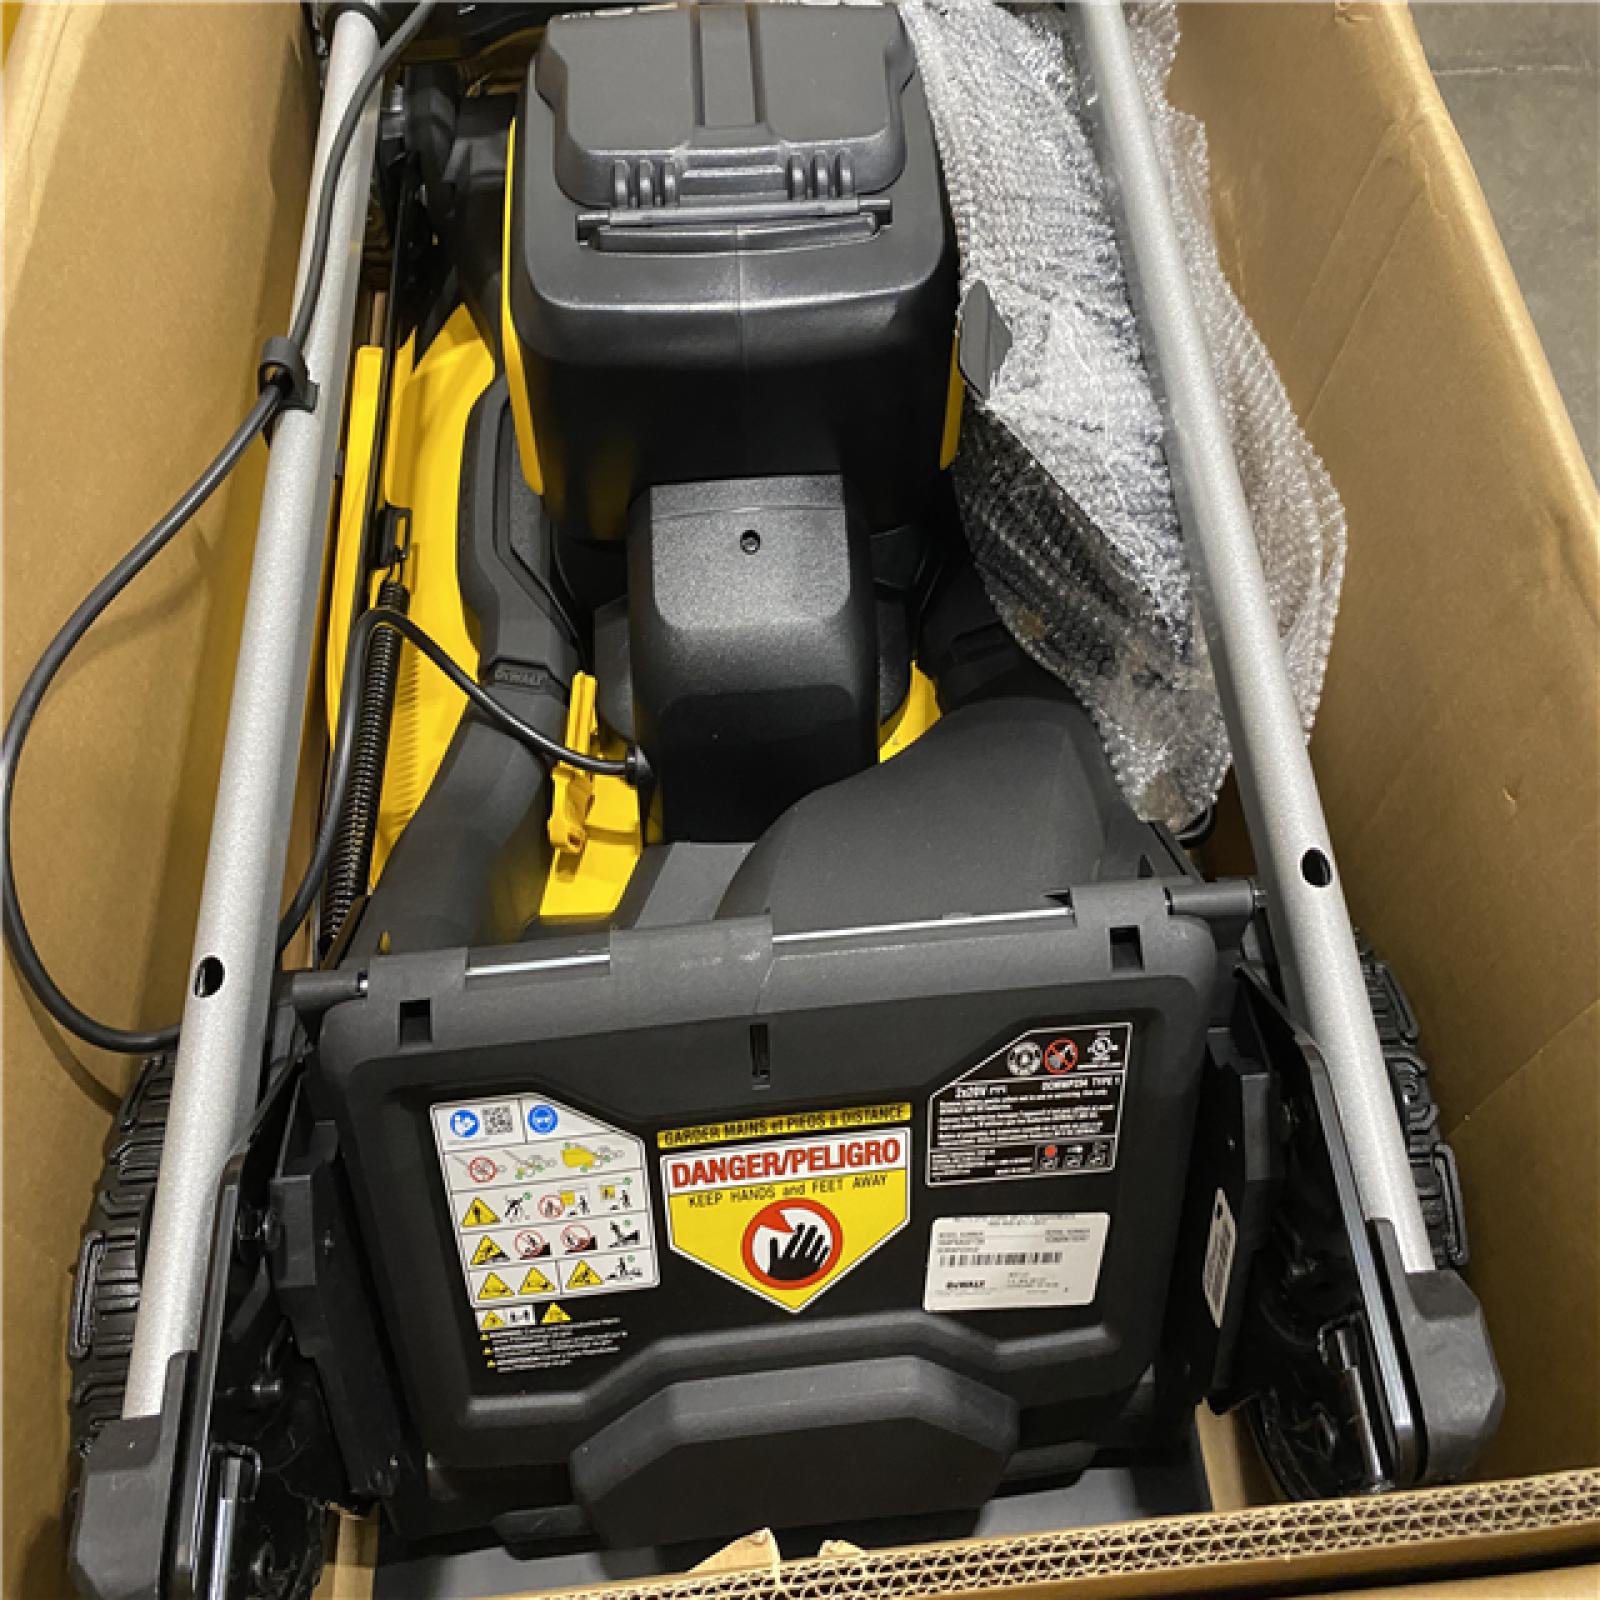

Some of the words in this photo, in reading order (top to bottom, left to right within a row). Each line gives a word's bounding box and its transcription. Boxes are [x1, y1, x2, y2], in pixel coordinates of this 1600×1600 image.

[724, 1119, 766, 1137] MAINS
[671, 1137, 900, 1188] DANGER/PELIGRO
[689, 1192, 723, 1208] KEEP
[730, 1185, 776, 1203] HANDS
[782, 1184, 806, 1197] and
[812, 1177, 843, 1194] FEET
[852, 1174, 887, 1190] AWAY
